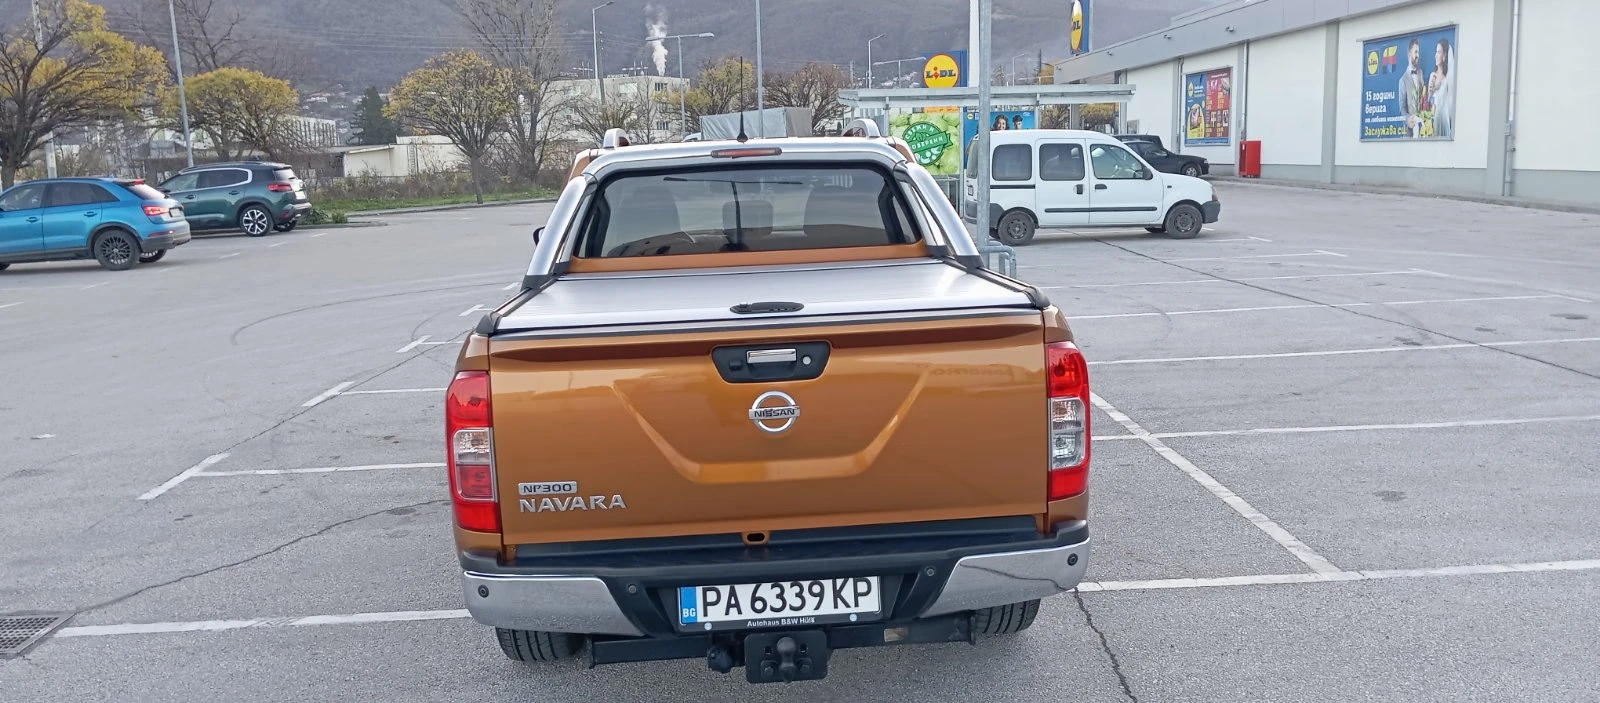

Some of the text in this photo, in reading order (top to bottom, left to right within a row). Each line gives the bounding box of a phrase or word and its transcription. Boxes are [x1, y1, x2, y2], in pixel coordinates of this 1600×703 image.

[1366, 91, 1372, 101] 15
[905, 124, 927, 139] СВЕЖИ
[911, 136, 944, 149] ОВЕРЕНИ
[754, 409, 796, 418] NISSAN
[523, 484, 572, 493] NP300
[519, 494, 627, 513] NAVARA
[702, 577, 872, 617] PA 6339 KP
[682, 608, 696, 618] BG
[747, 619, 780, 627] Autohaus
